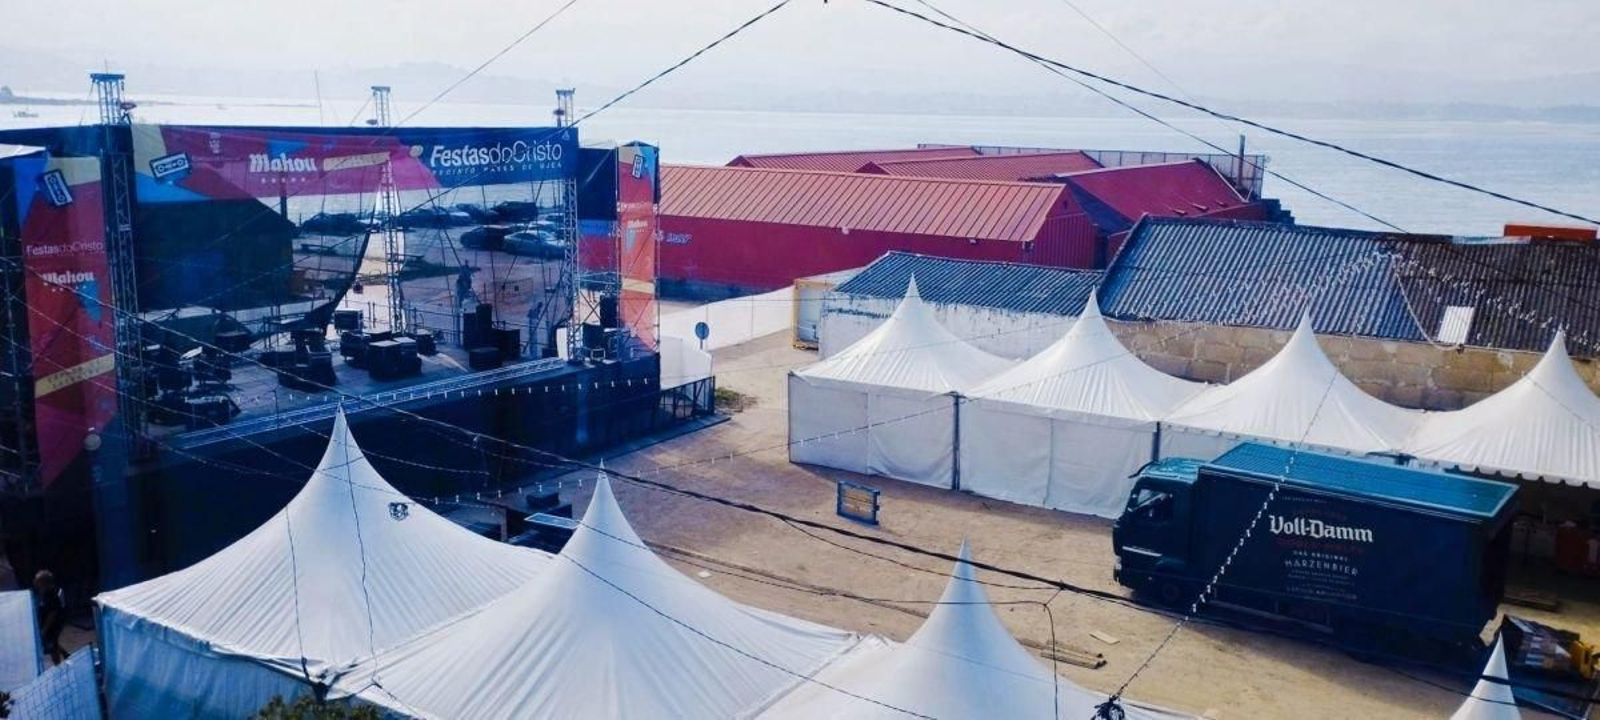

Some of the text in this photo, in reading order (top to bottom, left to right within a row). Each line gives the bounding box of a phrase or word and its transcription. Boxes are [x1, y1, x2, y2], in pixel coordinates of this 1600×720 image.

[249, 153, 318, 172] Mahou
[430, 140, 562, 168] FestasdoCristo
[1269, 515, 1374, 543] Voll-Damm
